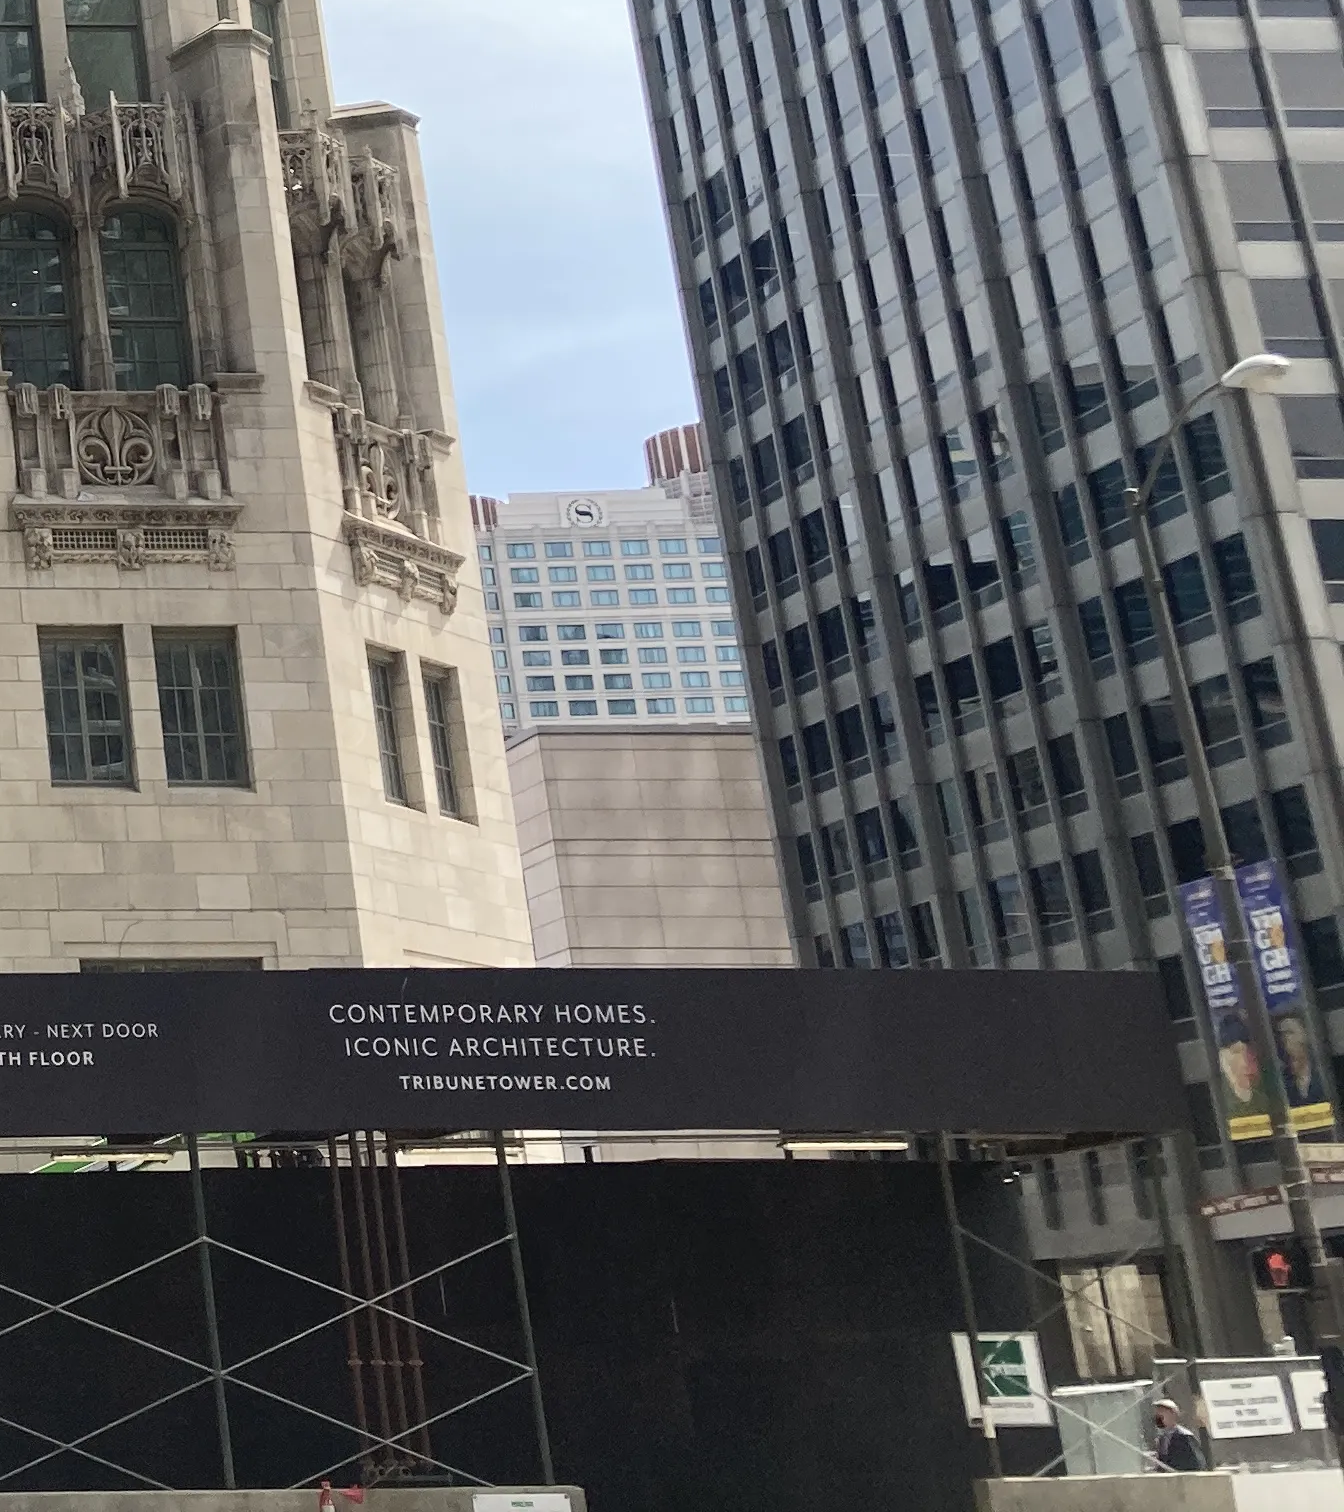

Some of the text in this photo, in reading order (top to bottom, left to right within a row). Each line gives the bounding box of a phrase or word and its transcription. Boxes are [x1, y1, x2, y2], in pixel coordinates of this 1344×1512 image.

[329, 1003, 656, 1024] CONTEMPORARY HOMES.
[47, 1023, 95, 1039] NEXT
[102, 1022, 159, 1038] DOOR
[345, 1037, 656, 1057] ICONIC ARCHITECTURE.
[28, 1050, 95, 1066] FLOOR
[398, 1075, 611, 1091] TRIBUNETOWER.COM
